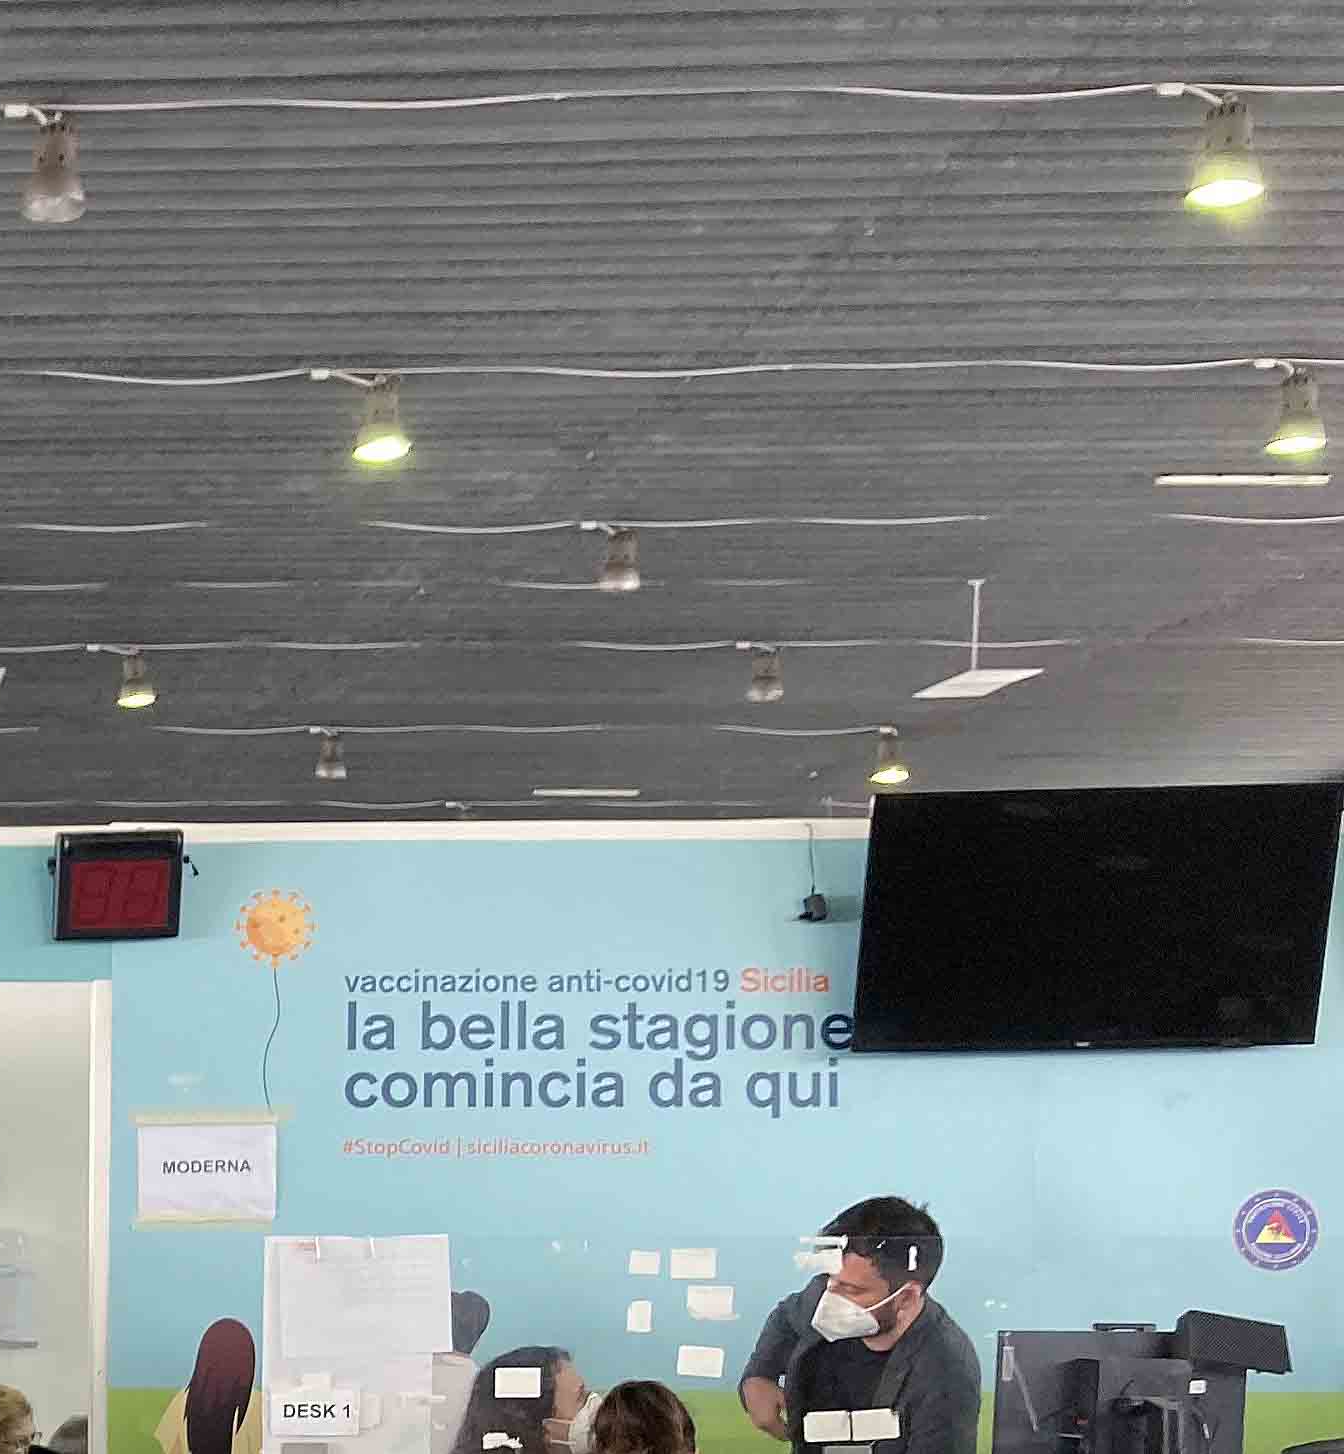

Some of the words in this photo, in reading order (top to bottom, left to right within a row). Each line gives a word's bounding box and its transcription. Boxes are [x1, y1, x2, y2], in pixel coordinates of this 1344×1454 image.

[344, 969, 537, 994] vaccinazione
[548, 969, 730, 994] anti-covid19
[740, 967, 830, 993] Sicilia
[347, 1000, 395, 1050] la
[421, 1000, 565, 1051] bella
[589, 1000, 853, 1061] stagione
[344, 1058, 624, 1108] comincia
[648, 1058, 721, 1108] da
[746, 1058, 839, 1118] qui
[343, 1137, 449, 1158] #StopCovid
[468, 1137, 649, 1155] siciliacoronavirus.it
[162, 1159, 252, 1174] MODERNA
[283, 1404, 336, 1418] DESK
[343, 1404, 351, 1418] 1
